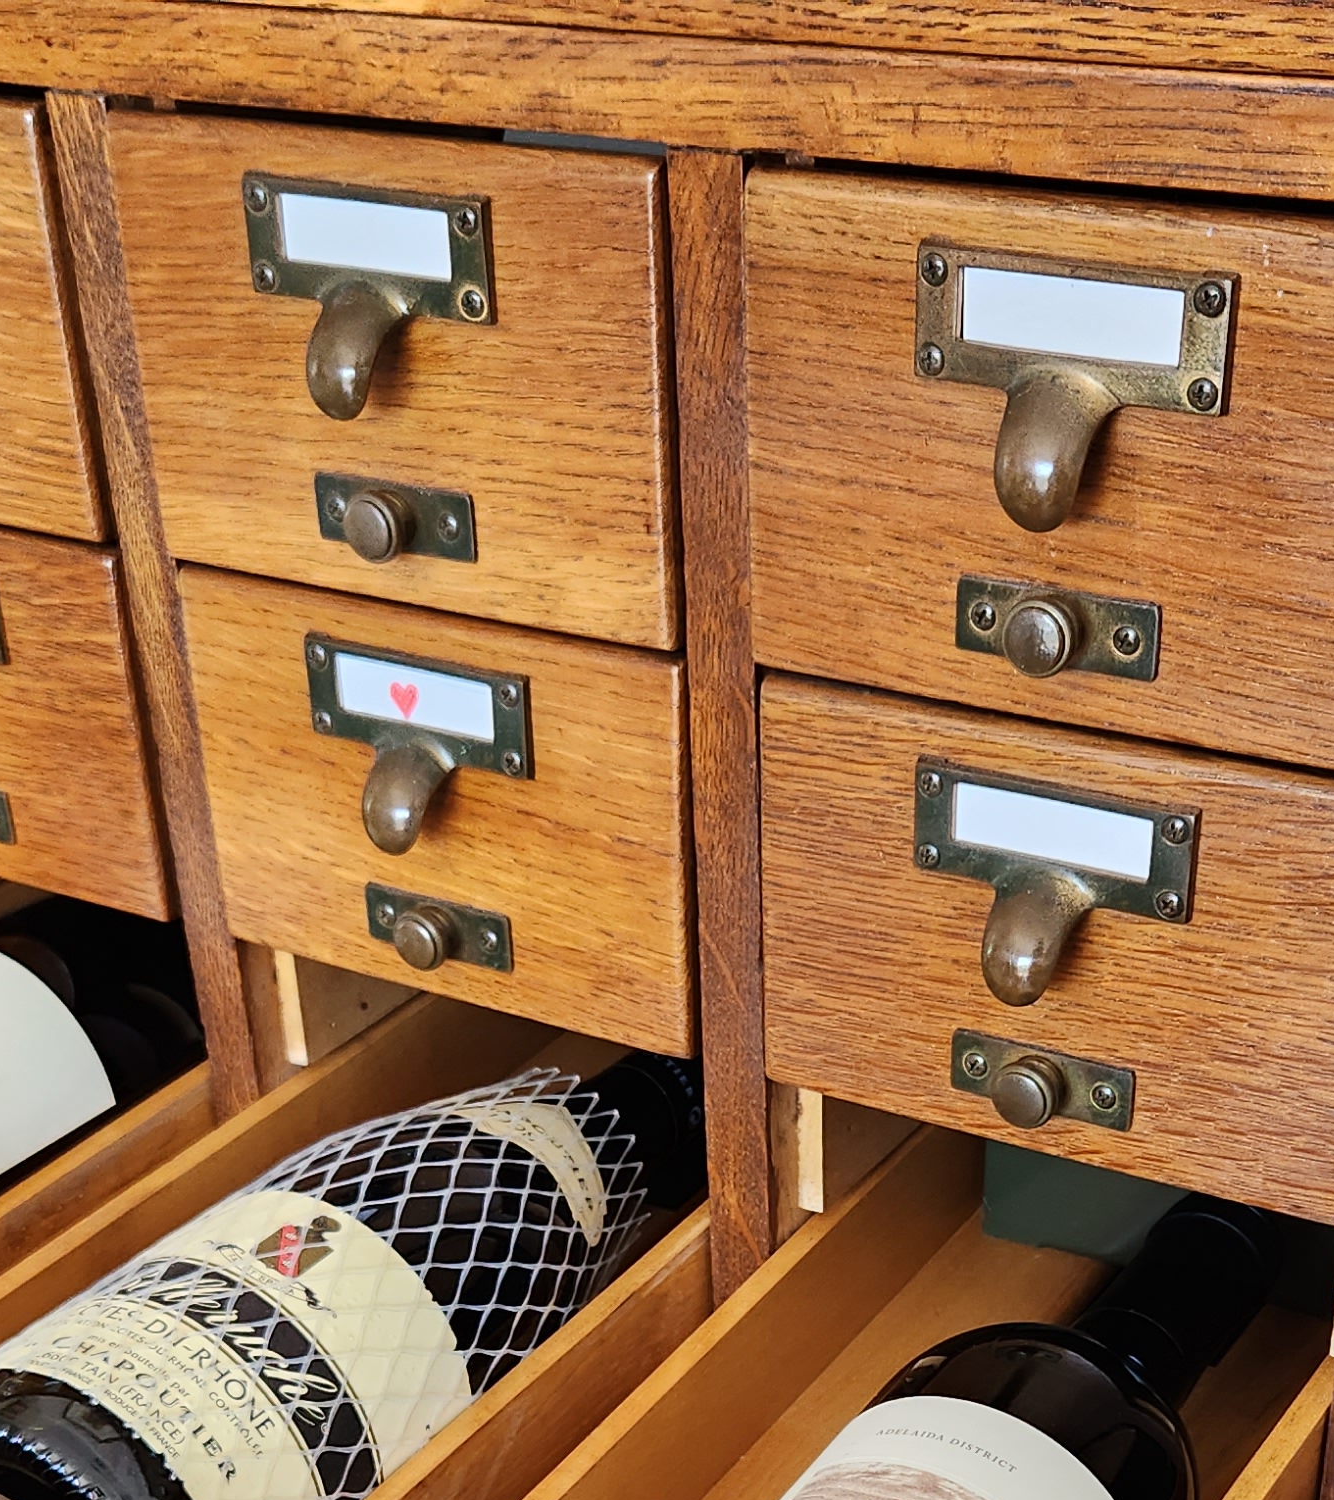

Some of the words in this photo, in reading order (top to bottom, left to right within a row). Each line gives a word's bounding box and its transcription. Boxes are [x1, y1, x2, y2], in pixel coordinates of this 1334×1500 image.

[170, 1381, 191, 1398] par
[876, 1428, 945, 1442] ADELAIDA
[949, 1437, 1018, 1473] DISTRICT
